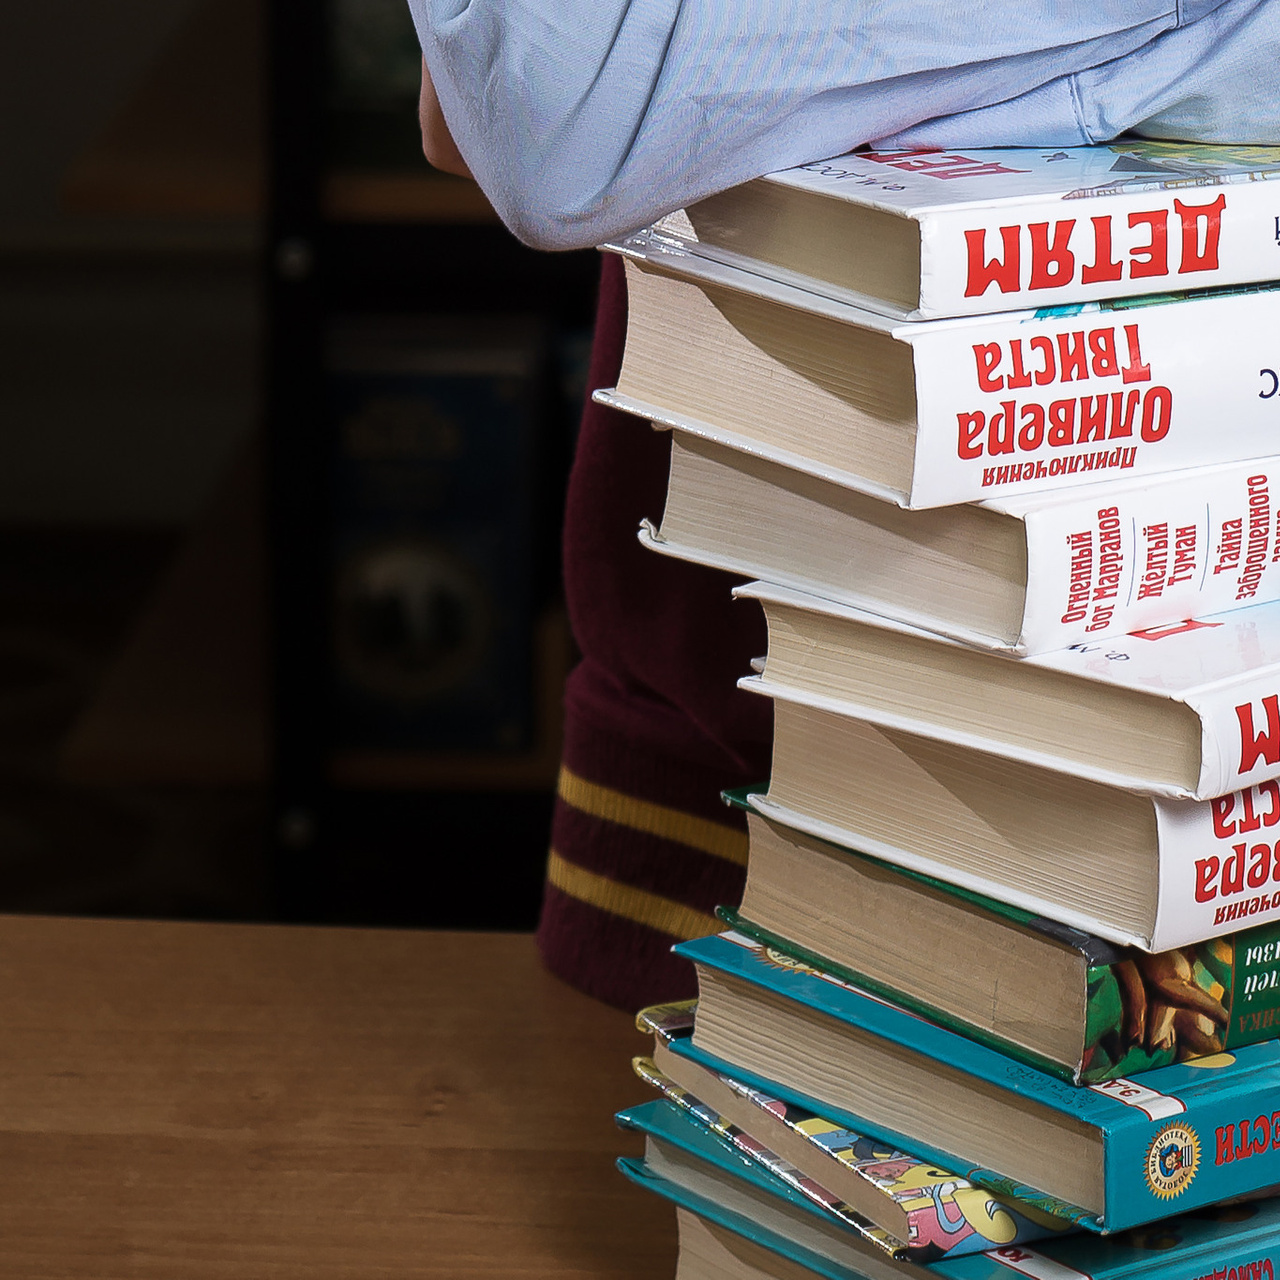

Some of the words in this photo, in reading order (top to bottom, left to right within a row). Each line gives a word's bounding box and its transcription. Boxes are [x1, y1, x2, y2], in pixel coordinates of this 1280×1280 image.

[962, 193, 1227, 300] ДЕТЯМ
[972, 323, 1153, 393] Твиста
[956, 386, 1173, 461] Оливера
[981, 446, 1138, 488] Приключения
[1091, 506, 1124, 602] Марранов
[1137, 521, 1169, 601] Жёлтый
[1213, 517, 1243, 575] Тайна
[1235, 474, 1271, 600] заброшенного
[1061, 530, 1093, 625] Огненный
[1085, 605, 1116, 633] бог
